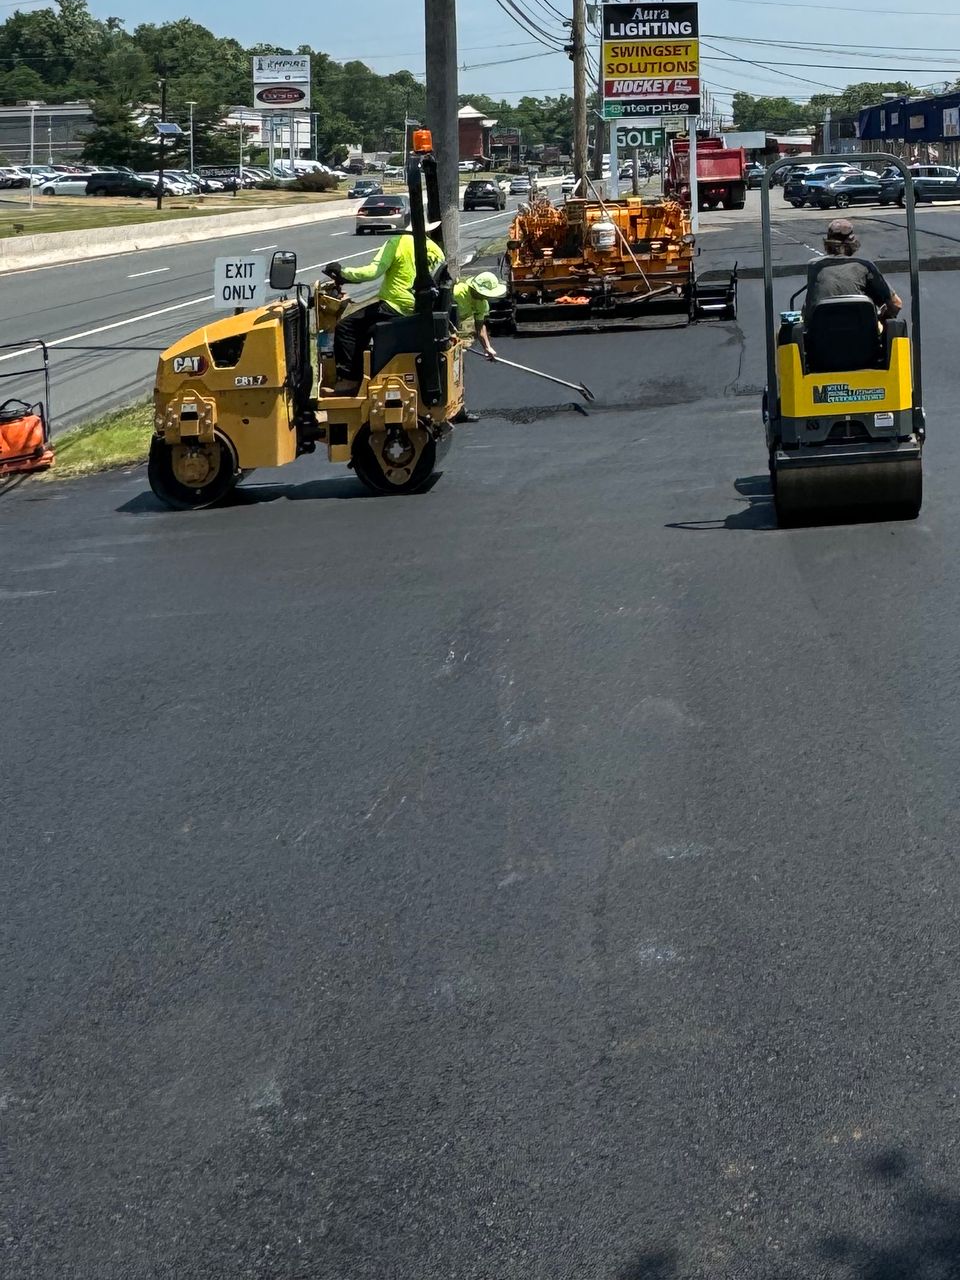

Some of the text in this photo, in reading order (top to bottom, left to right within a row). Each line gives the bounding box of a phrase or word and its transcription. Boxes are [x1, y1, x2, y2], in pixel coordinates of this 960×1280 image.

[632, 7, 669, 20] Aura
[610, 21, 693, 36] LIGHTING
[611, 44, 691, 58] SWINGSET
[606, 61, 698, 74] SOLUTIONS
[612, 79, 673, 94] HOCKEY
[609, 102, 689, 114] enterprise
[225, 263, 256, 278] EXIT
[223, 285, 256, 300] ONLY
[173, 356, 200, 373] CAT
